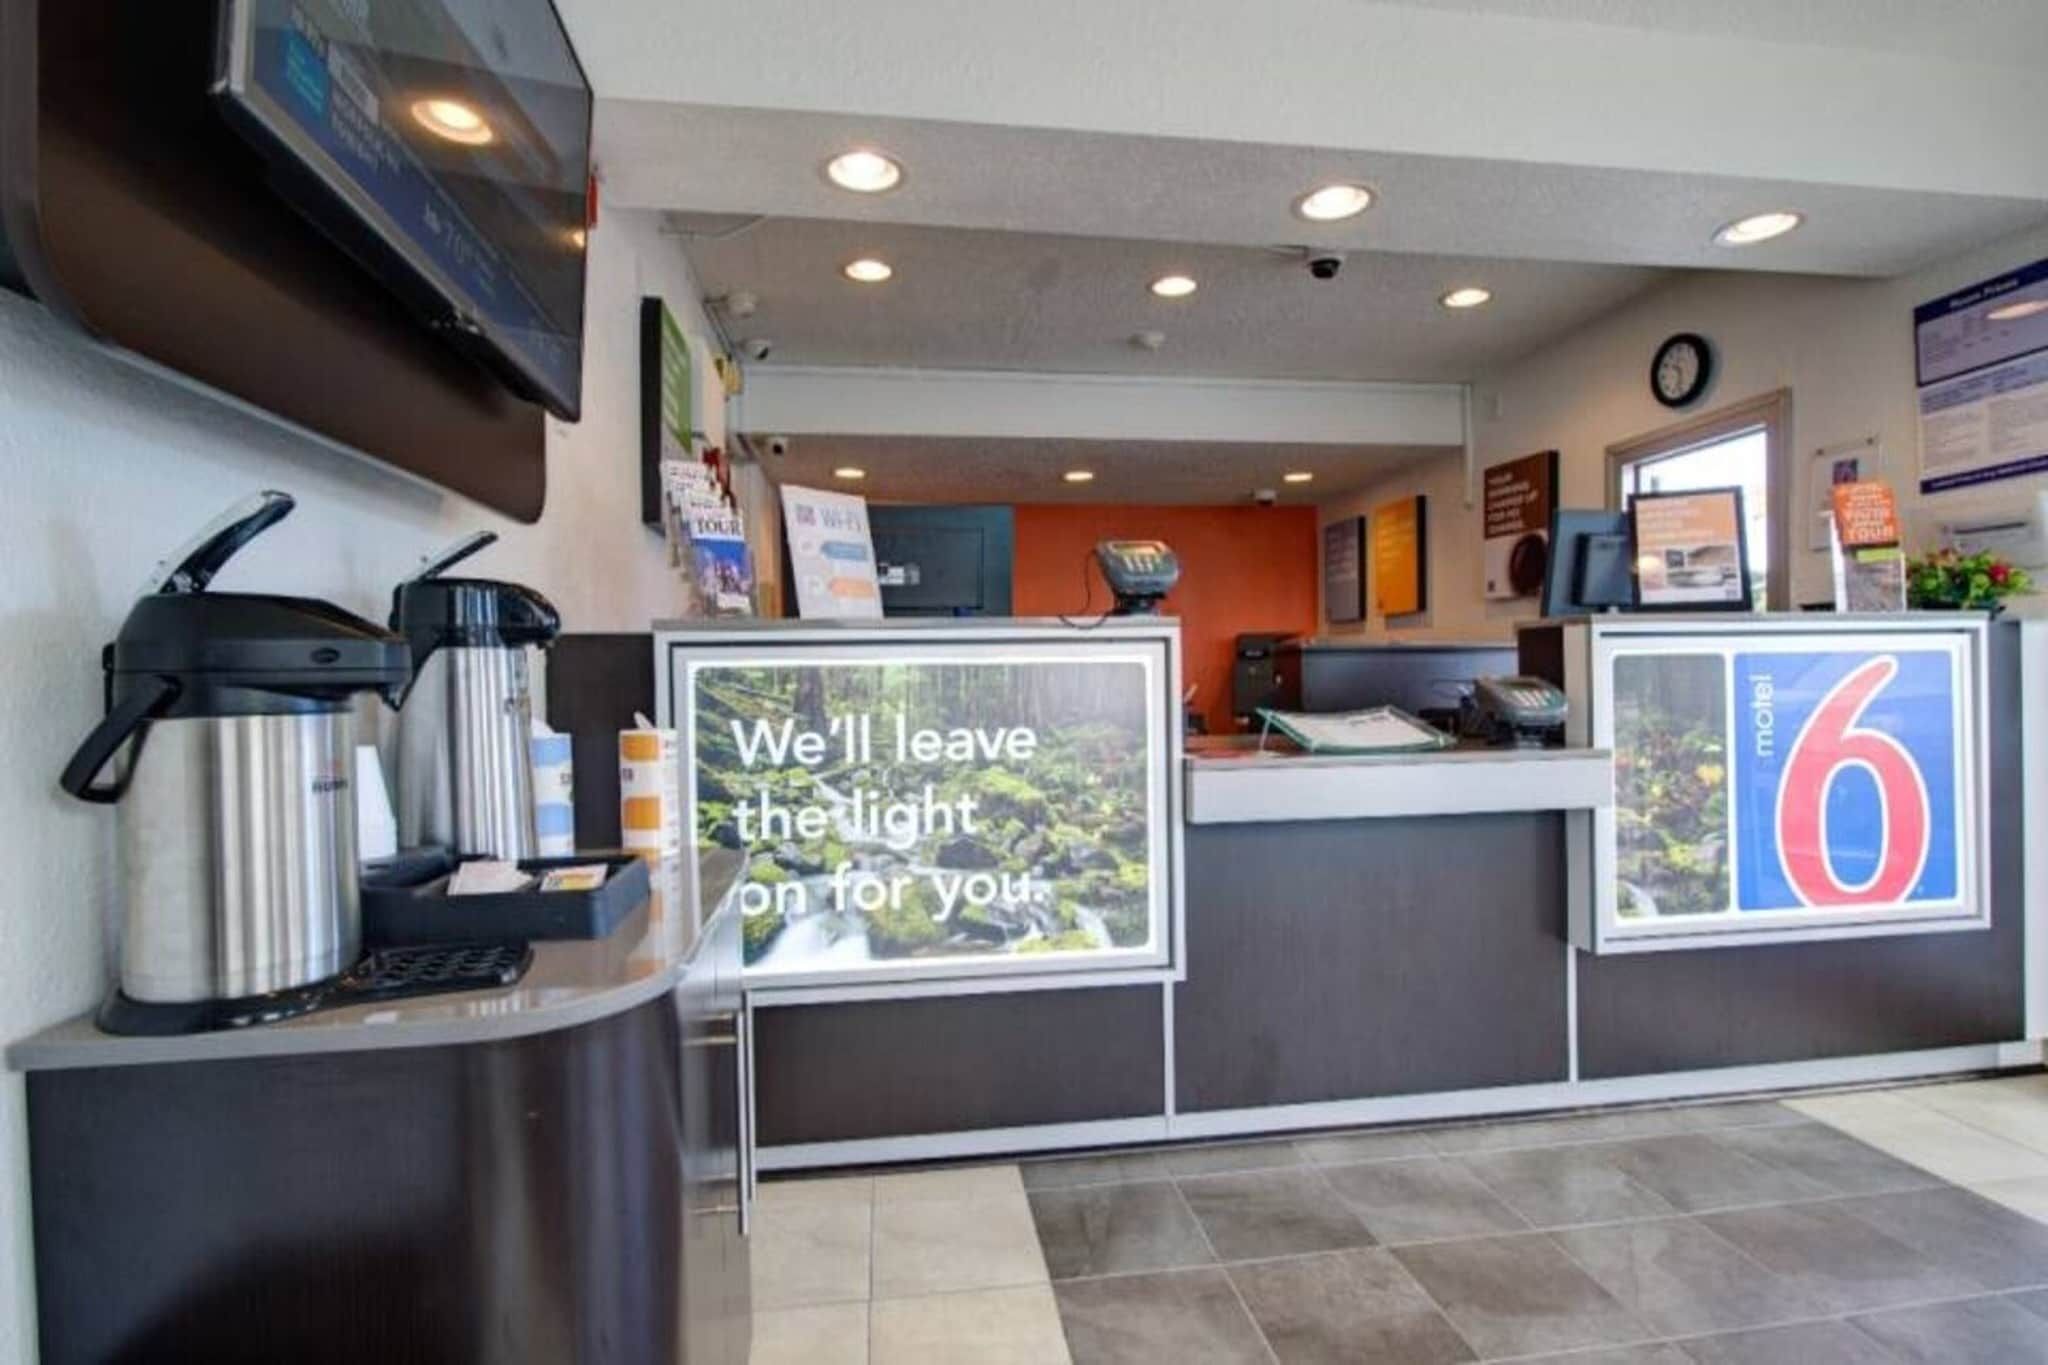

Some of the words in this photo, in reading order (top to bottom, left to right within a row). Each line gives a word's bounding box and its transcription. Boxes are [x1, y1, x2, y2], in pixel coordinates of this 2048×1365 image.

[729, 713, 871, 766] We'll
[895, 712, 1037, 764] leave
[1750, 674, 1774, 756] motel
[1775, 654, 1931, 909] 6
[732, 788, 827, 841] the
[851, 783, 979, 850] light
[738, 878, 807, 917] on
[831, 860, 913, 912] for
[934, 868, 1045, 921] you.
